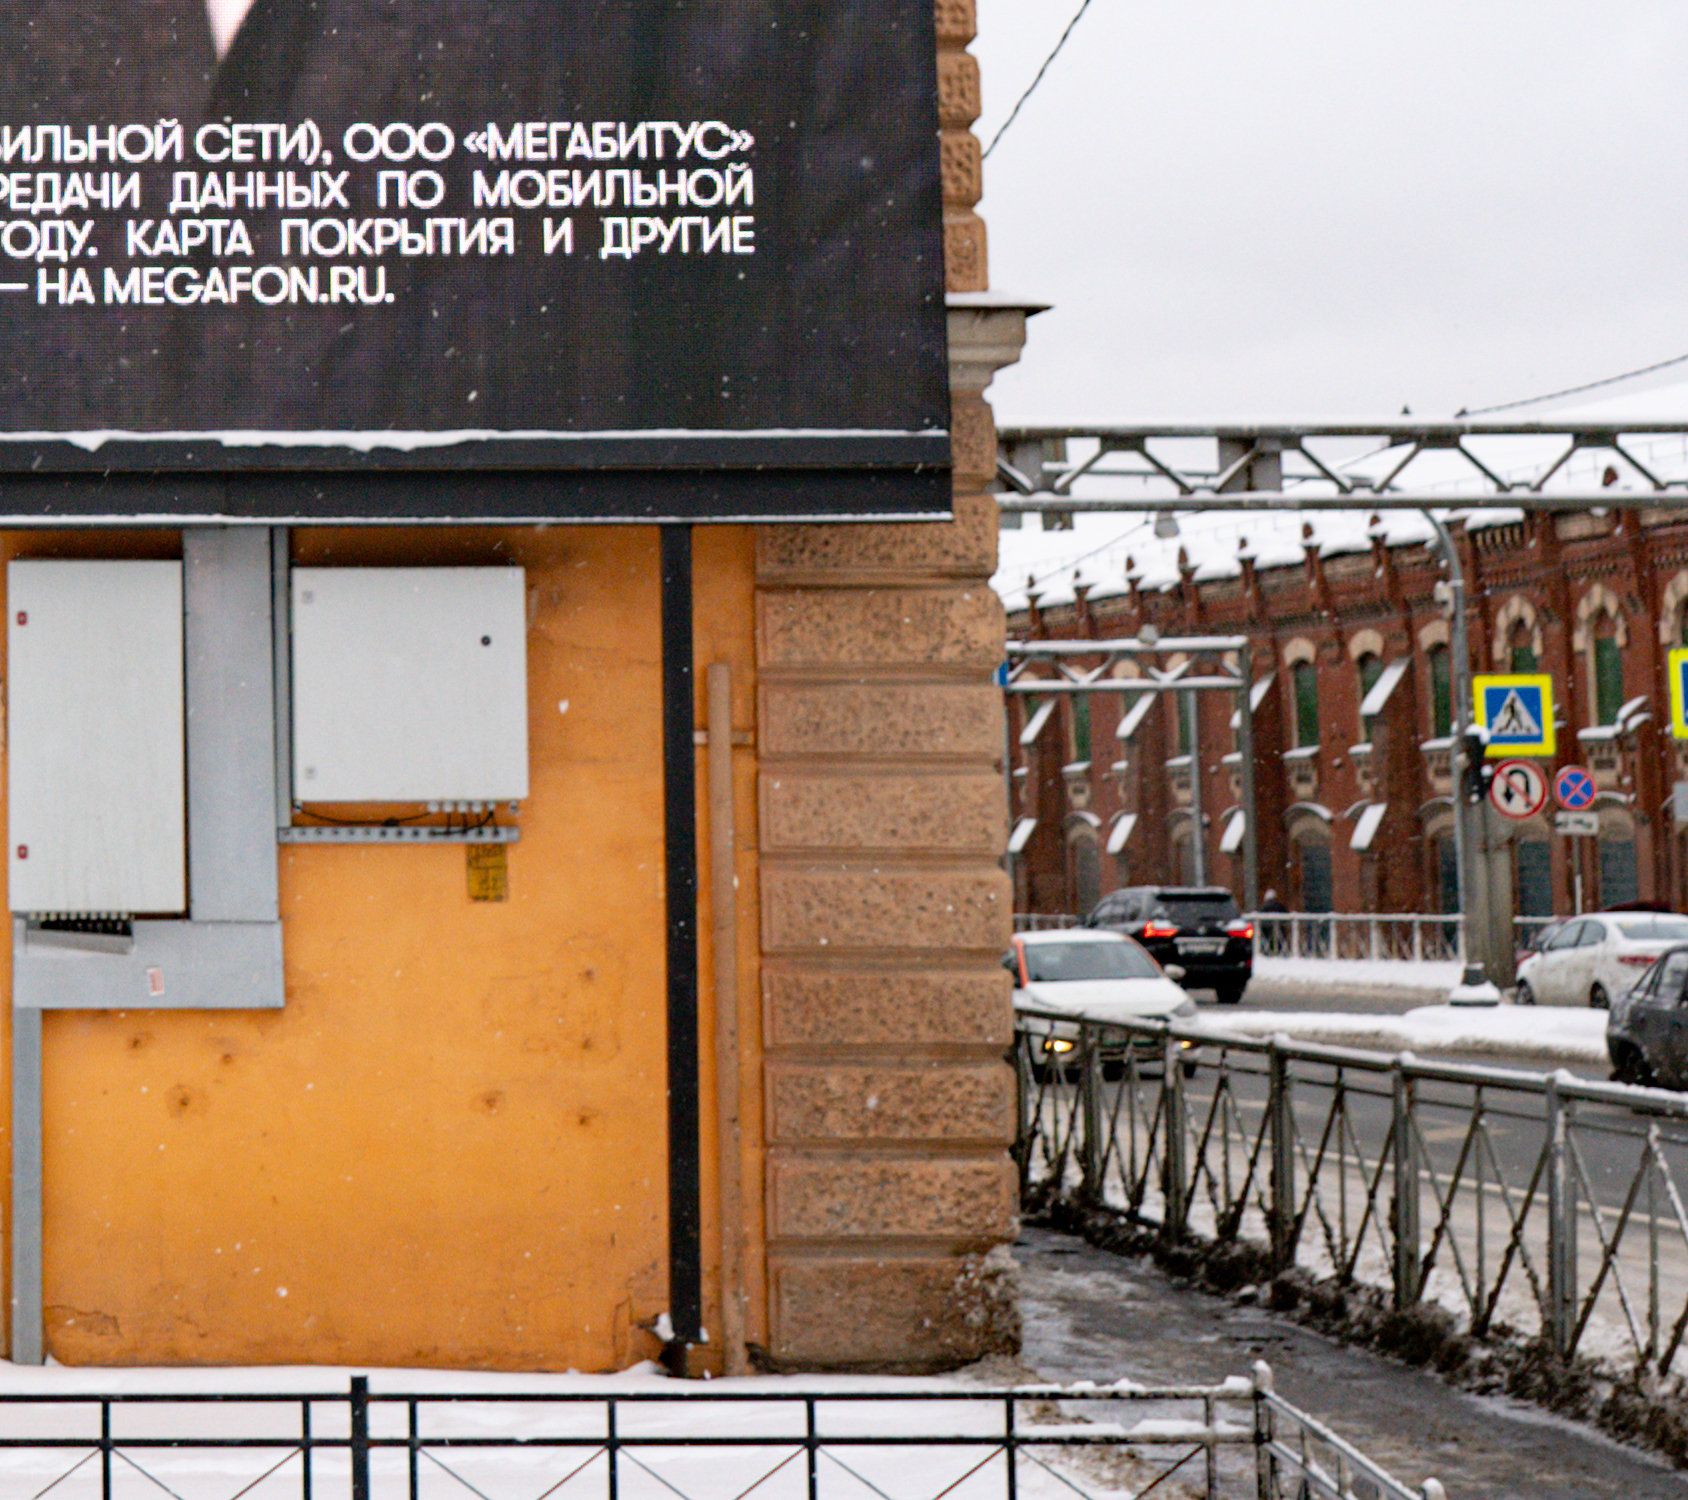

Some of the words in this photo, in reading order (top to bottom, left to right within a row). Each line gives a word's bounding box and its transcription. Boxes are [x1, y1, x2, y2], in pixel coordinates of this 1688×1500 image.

[195, 118, 332, 166] СЕТИ),
[344, 122, 454, 161] ООО
[464, 121, 754, 160] «МЕГАБИТУС»
[169, 171, 349, 214] ДАННЫХ
[377, 170, 445, 209] ПО
[473, 163, 753, 209] МОБИЛЬНОЙ
[127, 219, 254, 258] КАРТА
[281, 218, 514, 257] ПОКРЫТИЯ
[543, 217, 573, 254] И
[600, 216, 755, 259] ДРУГИЕ
[38, 268, 95, 304] НА
[104, 266, 395, 305] MEGAFON.RU.
